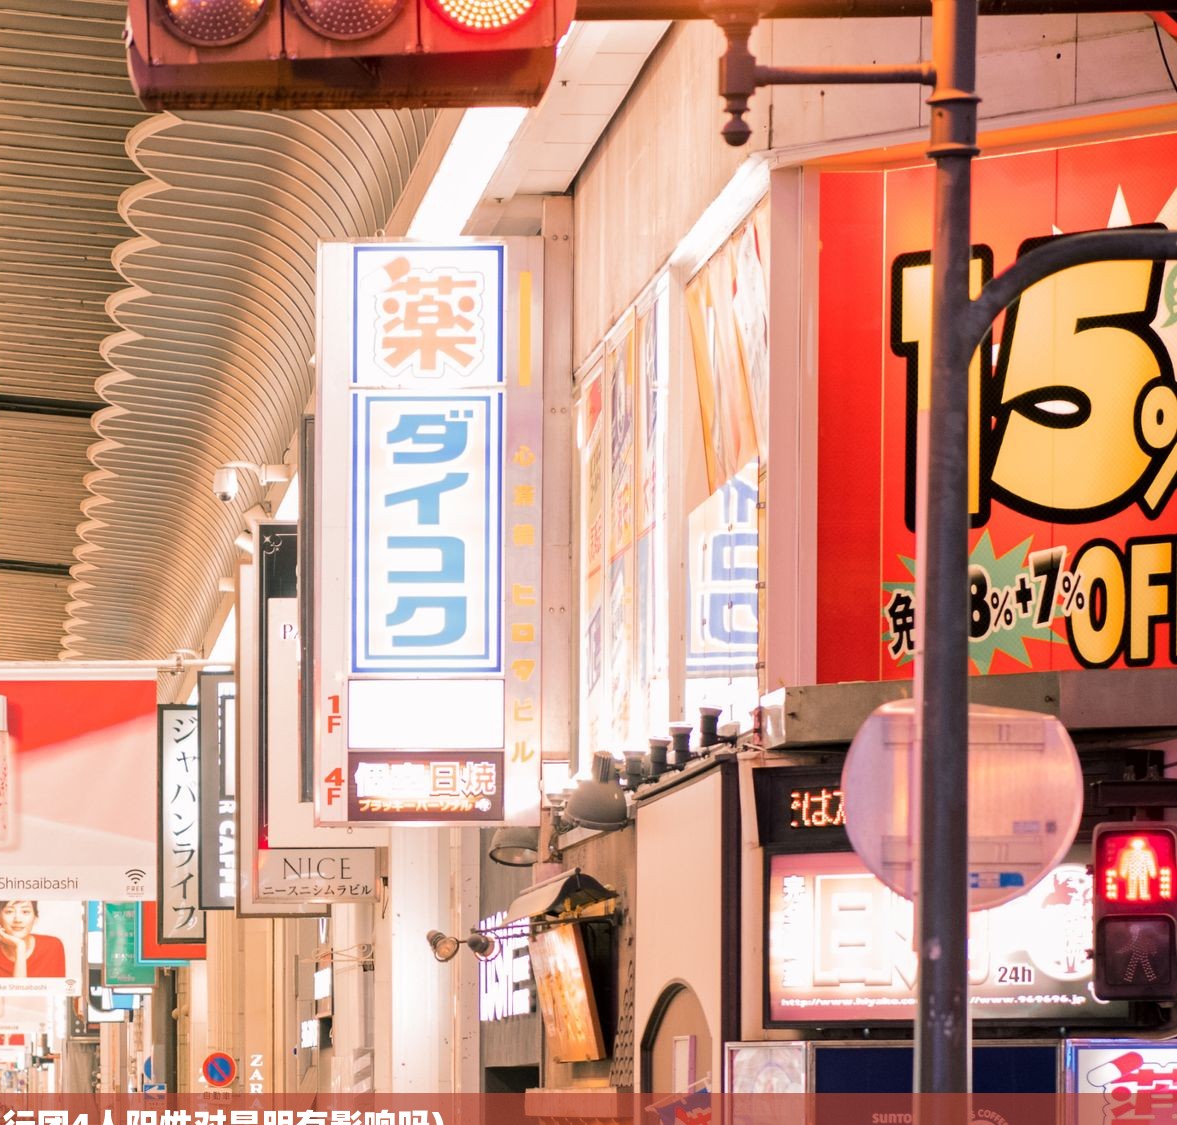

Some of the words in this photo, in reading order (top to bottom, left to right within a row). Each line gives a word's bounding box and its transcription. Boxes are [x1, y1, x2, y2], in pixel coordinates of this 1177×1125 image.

[382, 258, 477, 370] 薬
[385, 410, 473, 647] ダイコク
[1065, 538, 1177, 668] OF
[327, 695, 343, 733] 1F
[324, 767, 345, 805] 4F
[282, 857, 352, 880] NICE
[263, 884, 373, 897] ニースニシムラビル
[997, 966, 1032, 983] 24h
